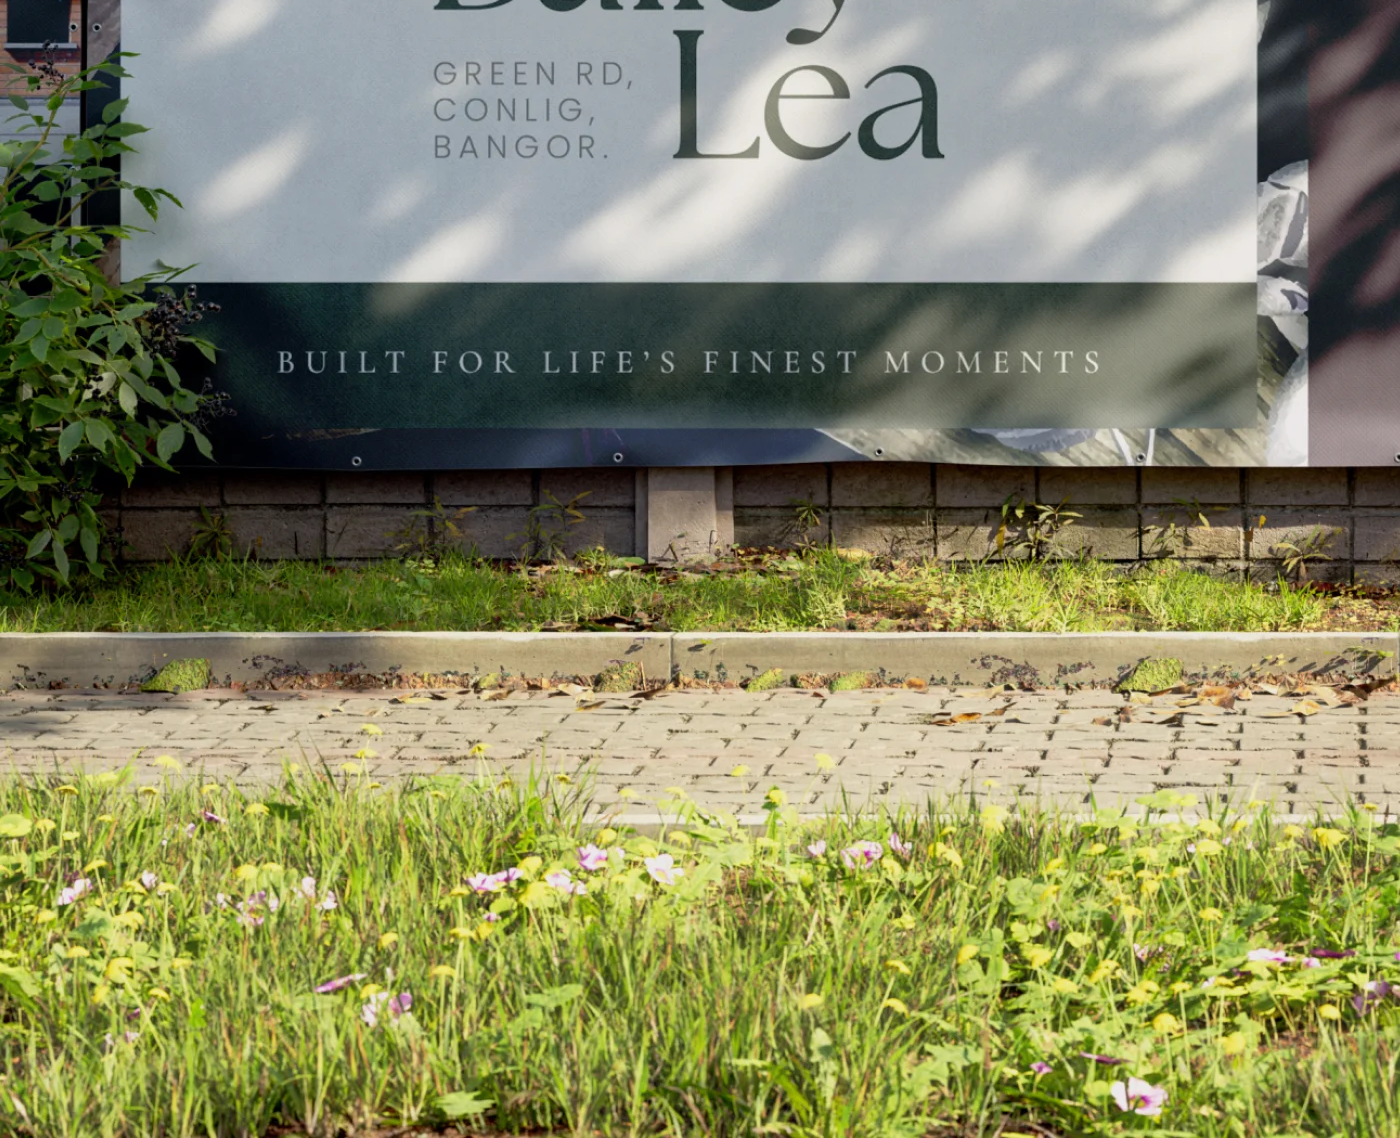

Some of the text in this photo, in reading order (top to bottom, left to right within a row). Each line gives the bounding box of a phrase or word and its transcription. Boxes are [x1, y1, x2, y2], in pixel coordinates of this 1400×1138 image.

[433, 61, 633, 90] GREEN RD,
[672, 29, 945, 161] Lea
[433, 97, 596, 127] CONLIG,
[434, 134, 609, 159] BANGOR.
[277, 350, 1100, 374] BUILT FOR LIFE’S FINEST MOMENTS
